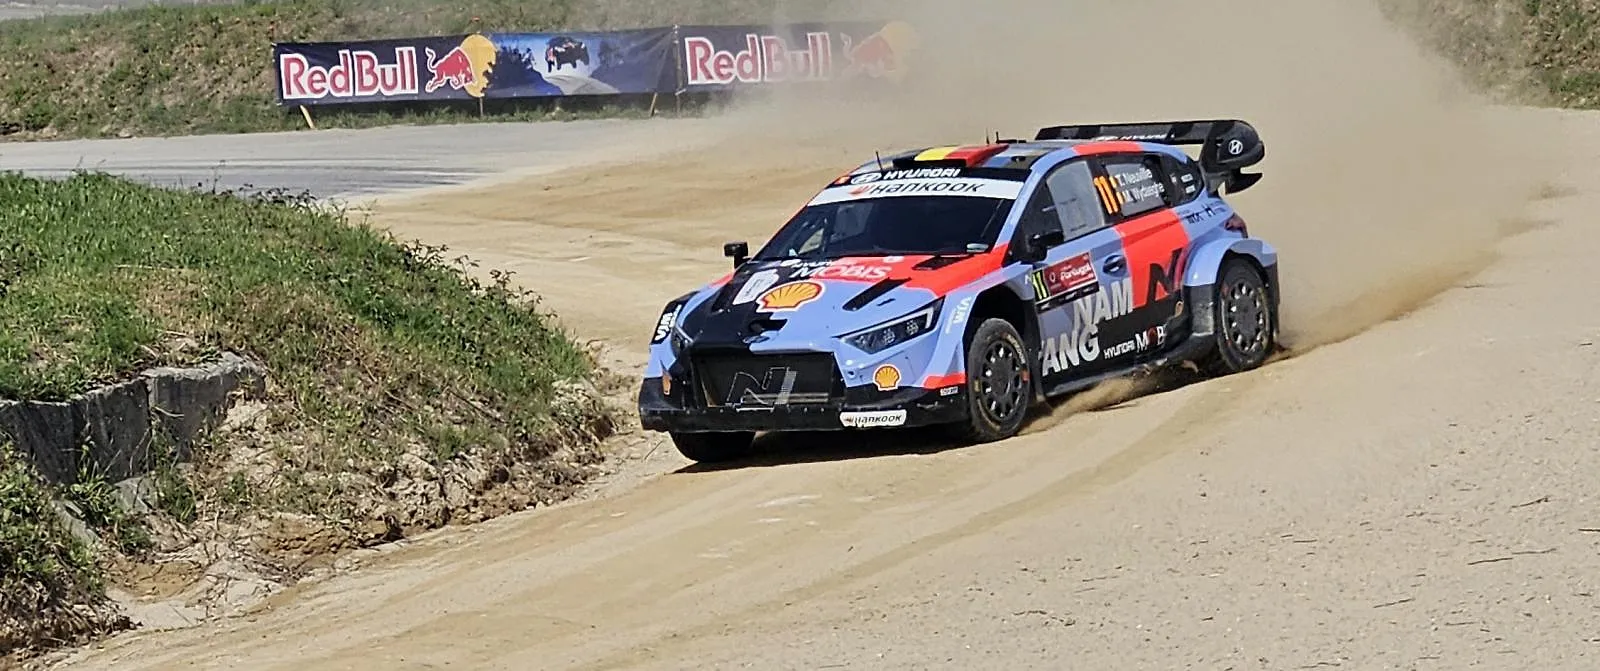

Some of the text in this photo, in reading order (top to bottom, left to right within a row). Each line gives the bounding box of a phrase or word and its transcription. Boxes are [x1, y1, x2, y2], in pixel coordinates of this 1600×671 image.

[281, 46, 418, 98] Red Bull
[685, 32, 831, 84] Red Bull
[884, 168, 960, 180] HYUNDAI
[1093, 175, 1119, 215] 11
[789, 265, 893, 279] MOBIS
[1031, 271, 1048, 300] 11
[1073, 278, 1134, 330] NAM
[1039, 323, 1100, 378] ANG
[1103, 325, 1166, 360] HYUNDAI MOB
